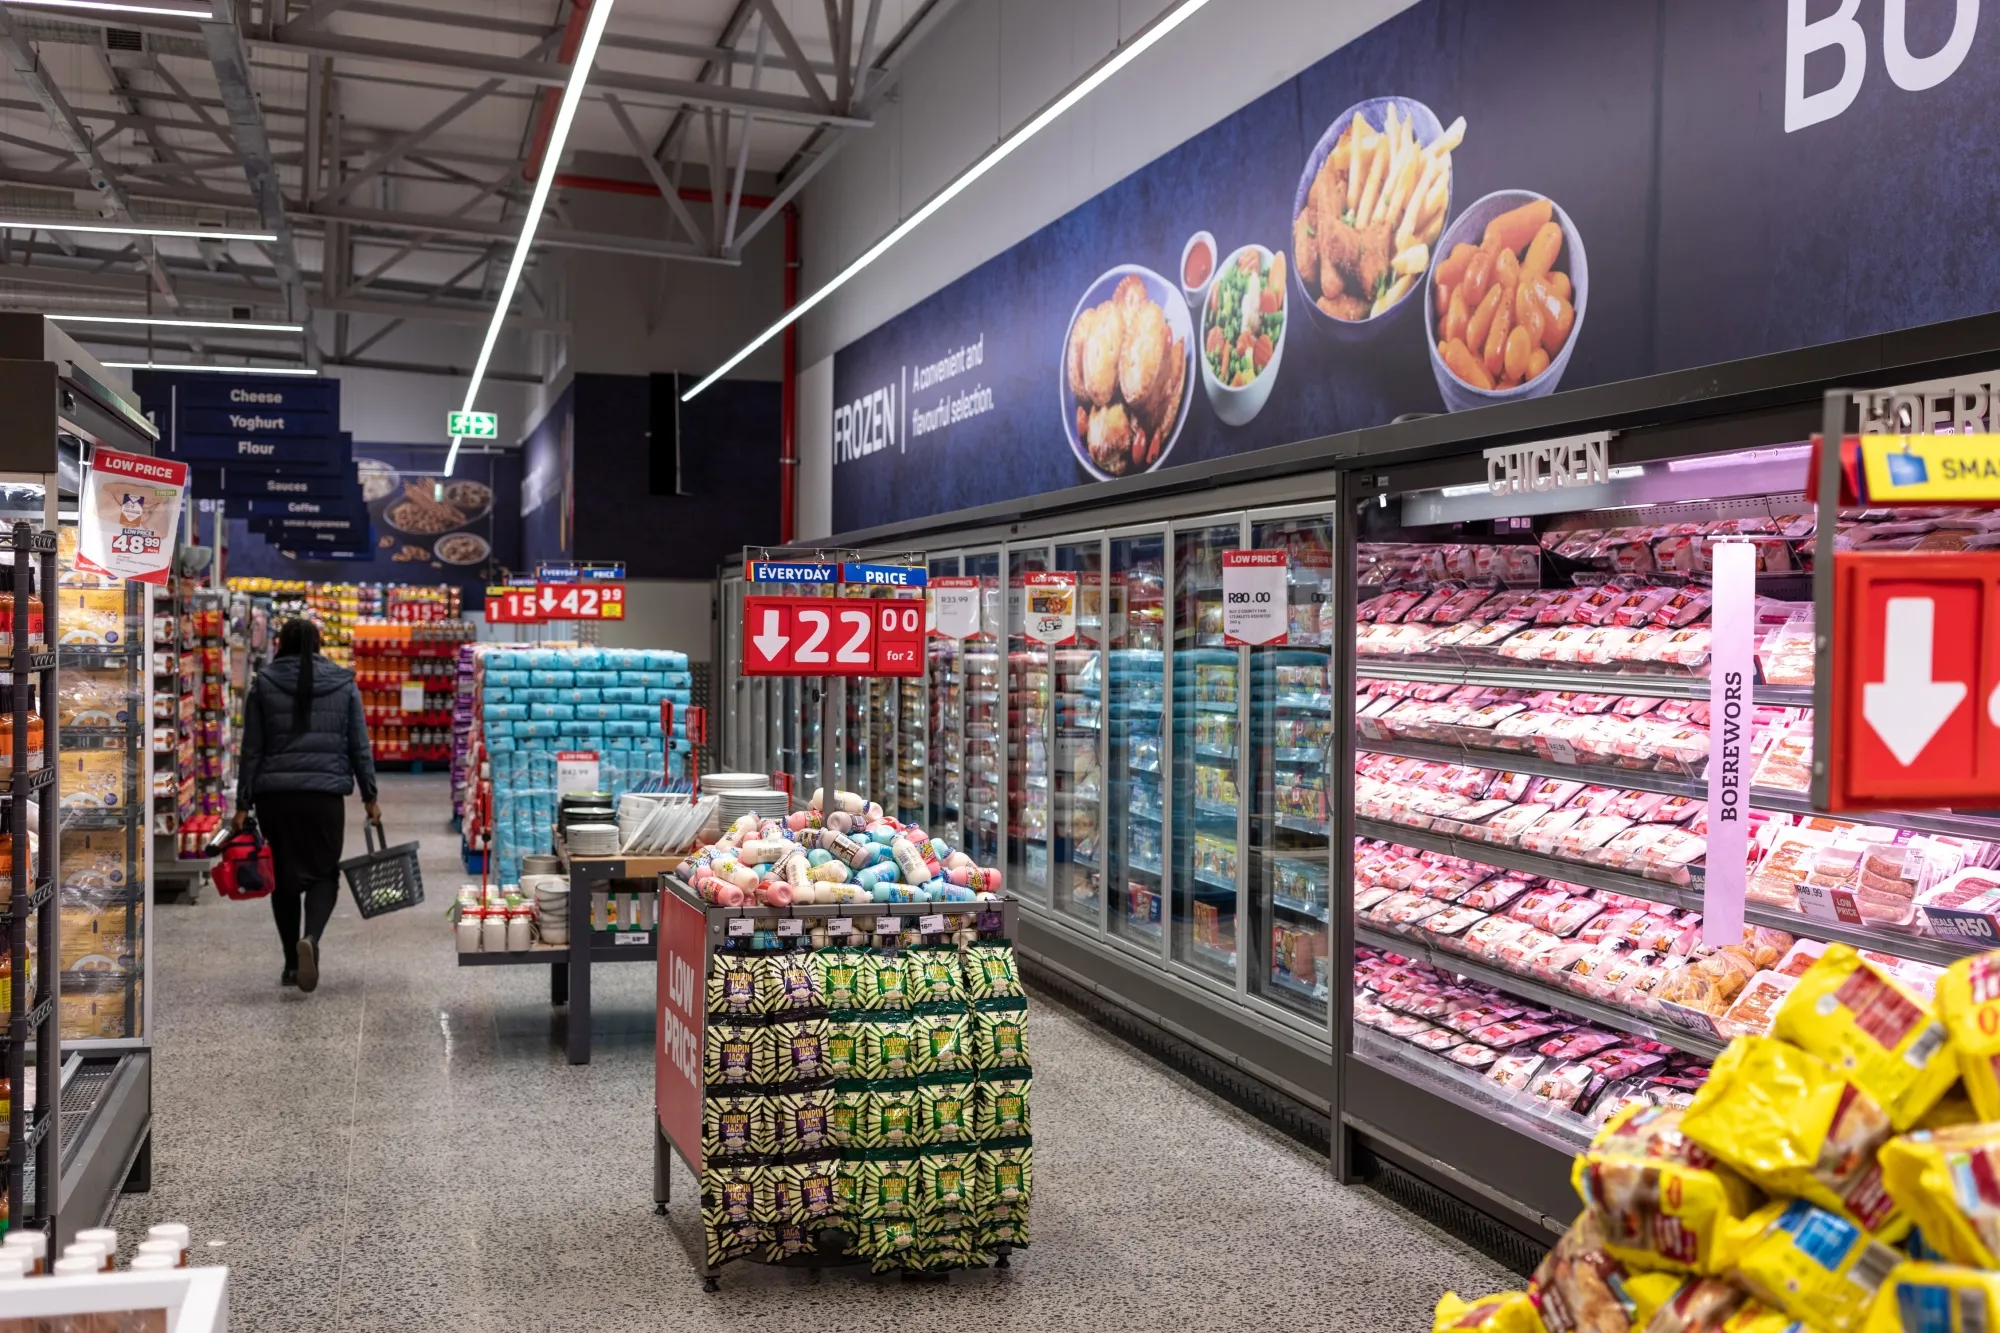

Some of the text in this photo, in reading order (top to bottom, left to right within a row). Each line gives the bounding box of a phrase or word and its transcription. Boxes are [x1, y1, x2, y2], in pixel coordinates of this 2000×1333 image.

[912, 332, 984, 394] A convenient and
[230, 390, 282, 404] Cheese
[230, 415, 284, 431] Yoghurt
[834, 383, 895, 465] FROZEN
[238, 441, 275, 454] Flour
[106, 458, 173, 478] LOW PRICE
[1487, 437, 1611, 496] CHICKEN
[267, 480, 308, 492] Sauces
[288, 503, 320, 513] Coffee
[112, 534, 160, 554] 48 99
[1231, 555, 1277, 564] LOW PRICE
[759, 568, 907, 585] EVERYDAY PRICE
[508, 595, 536, 616] 15
[561, 589, 598, 614] 42
[602, 588, 622, 600] 99
[1037, 621, 1054, 632] 45
[794, 608, 918, 663] 22 00
[887, 650, 914, 661] for 2
[1721, 672, 1742, 822] BOEREWORS
[1836, 898, 1851, 908] LOW
[1838, 906, 1858, 917] PRICE
[1931, 917, 1992, 938] DEALS R50
[1934, 926, 1960, 936] UNDER
[670, 950, 694, 1018] LOW
[996, 1027, 1018, 1035] JUMPIN
[794, 1038, 818, 1048] JUMPIN
[883, 1038, 908, 1046] JUMPIN
[1000, 1036, 1016, 1044] JACK
[665, 1007, 697, 1088] PRICE
[723, 1044, 750, 1053] JUMPIN
[800, 1046, 815, 1056] JACK
[834, 1048, 849, 1056] JACK
[888, 1046, 904, 1054] JACK
[728, 1054, 745, 1062] JACK
[937, 1102, 960, 1110] JUMPIN
[998, 1098, 1020, 1106] JUMPIN
[798, 1109, 823, 1120] JUMPIN
[941, 1110, 956, 1119] JACK
[1002, 1106, 1017, 1114] JACK
[723, 1114, 748, 1123] JUMPIN
[804, 1119, 820, 1128] JACK
[727, 1124, 743, 1132] JACK
[998, 1166, 1020, 1175] JUMPIN
[804, 1178, 828, 1188] JUMPIN
[882, 1178, 906, 1187] JUMPIN
[1002, 1175, 1016, 1184] JACK
[725, 1184, 750, 1192] JUMPIN
[809, 1188, 825, 1197] JACK
[886, 1187, 902, 1196] JACK
[730, 1192, 746, 1201] JACK
